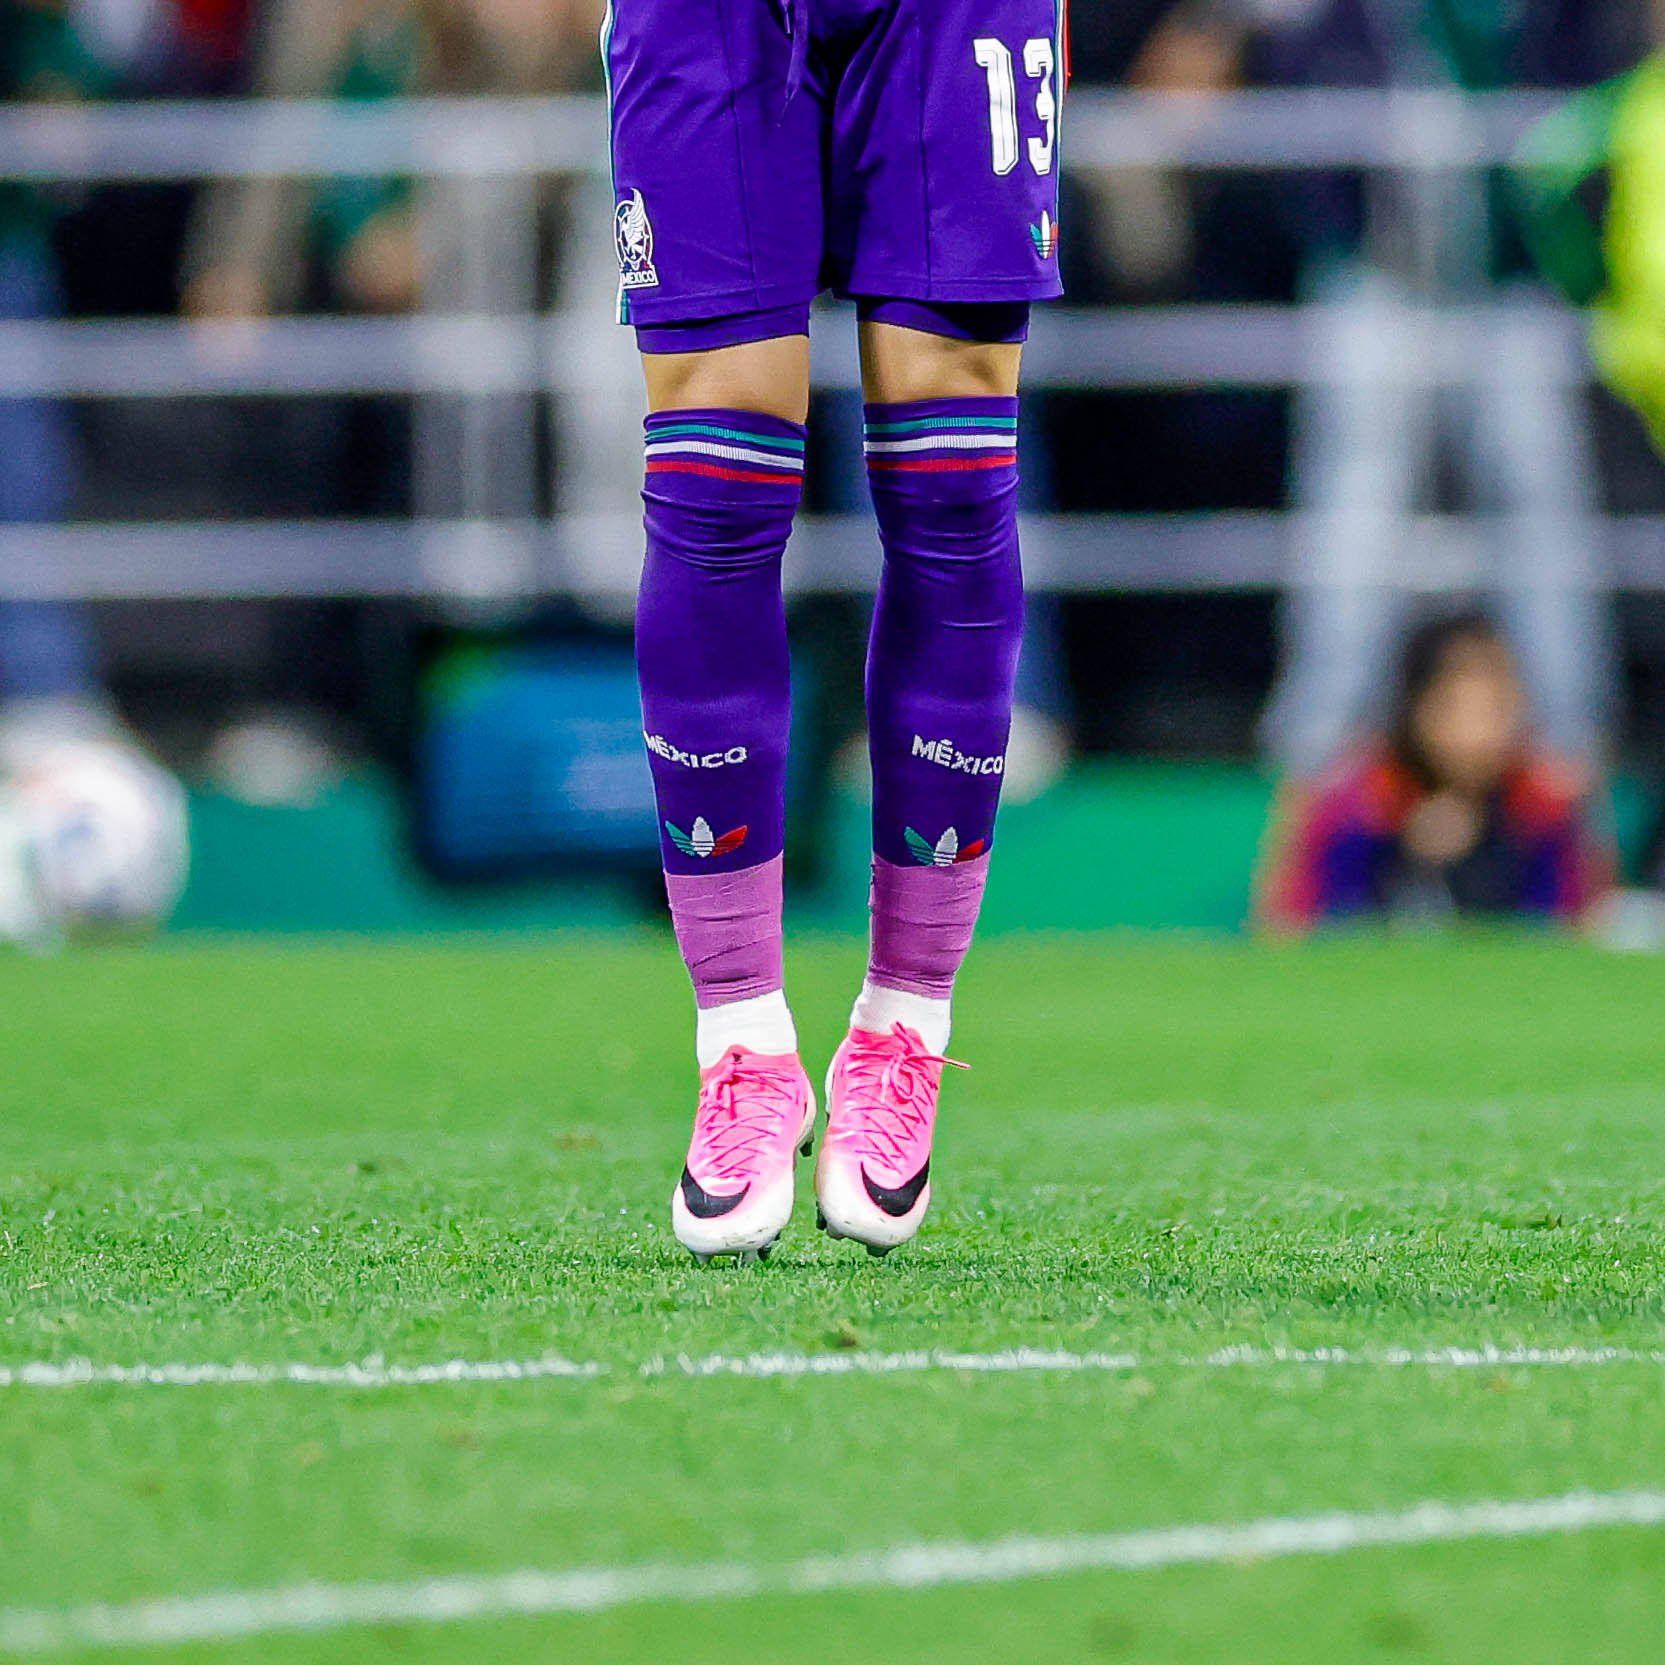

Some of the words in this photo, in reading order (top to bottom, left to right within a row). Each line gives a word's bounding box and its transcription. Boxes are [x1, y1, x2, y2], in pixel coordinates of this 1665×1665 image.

[973, 38, 1056, 176] 13
[643, 730, 747, 768] MÉXICO
[912, 734, 1004, 775] MÉXICO
